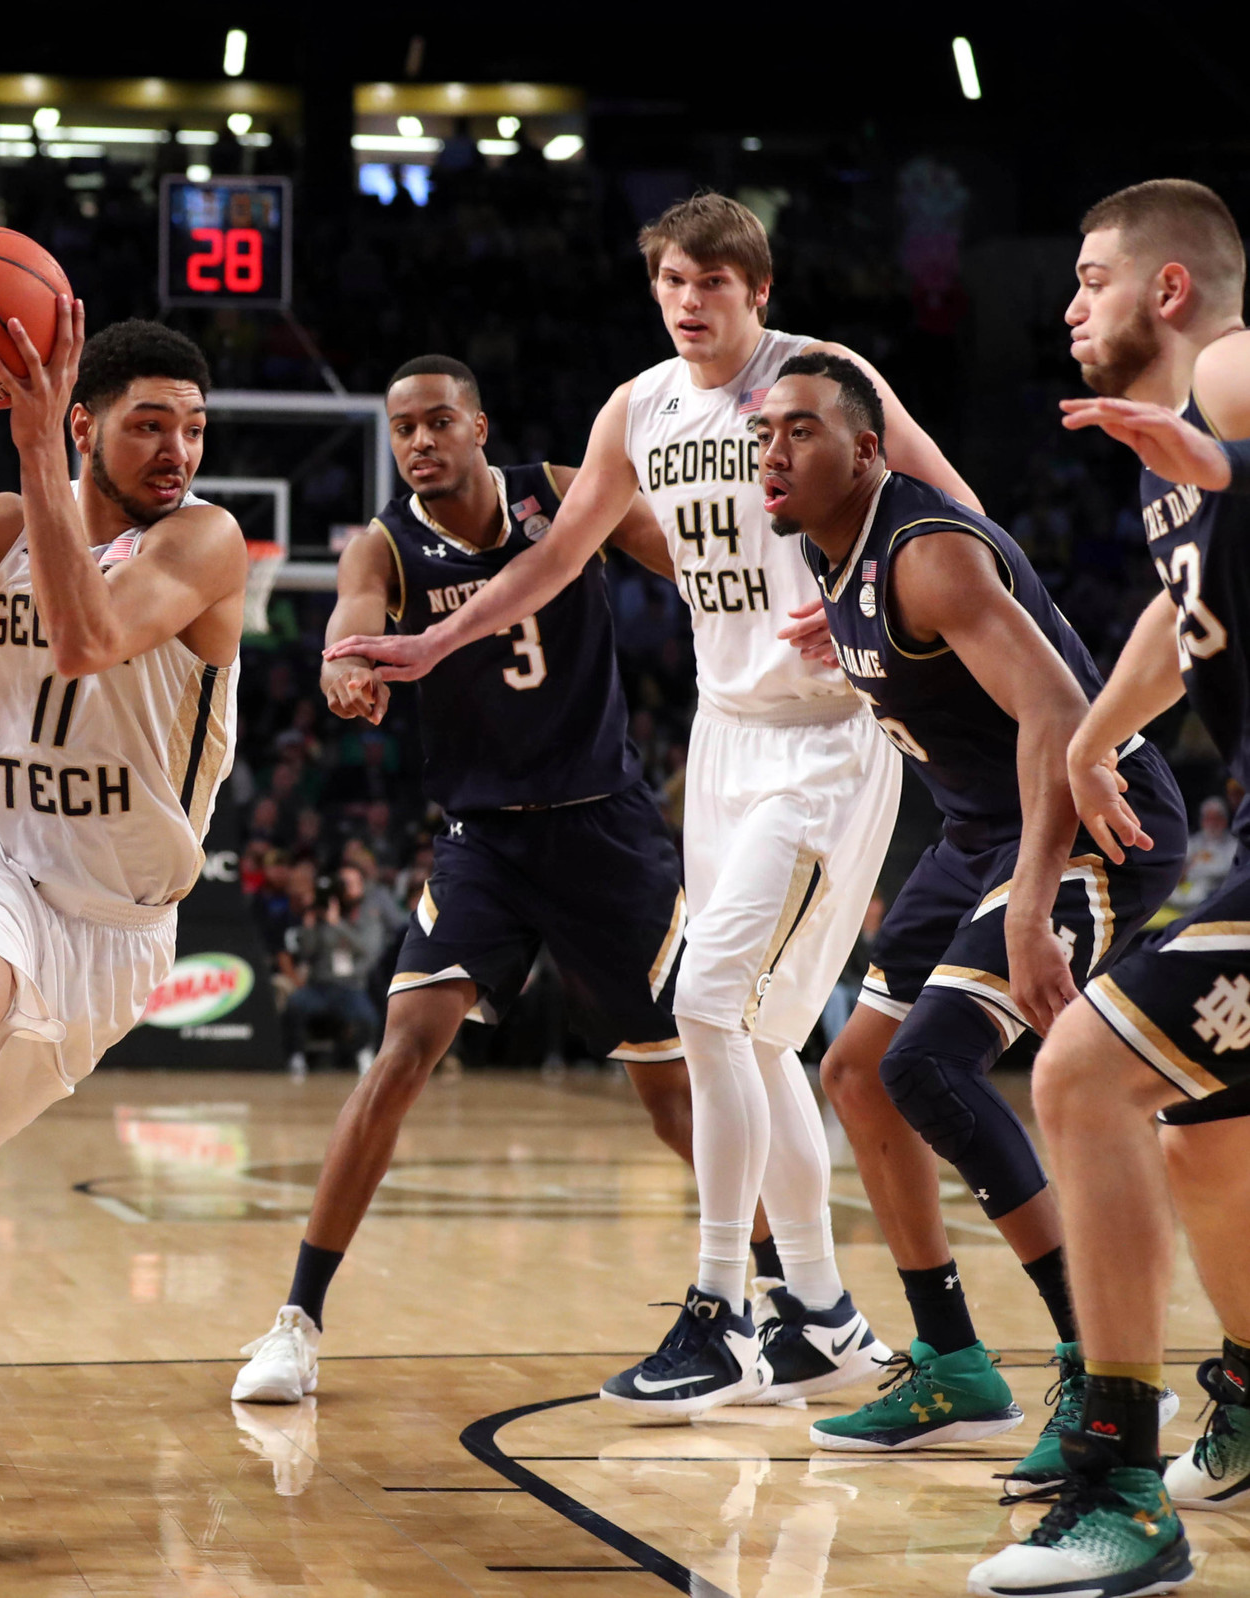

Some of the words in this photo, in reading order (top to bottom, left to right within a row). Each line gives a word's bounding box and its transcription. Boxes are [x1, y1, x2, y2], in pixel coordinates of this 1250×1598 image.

[186, 227, 263, 293] 28
[676, 495, 741, 559] 44
[427, 579, 490, 613] NOT
[681, 567, 770, 614] TECH
[30, 675, 79, 748] 11
